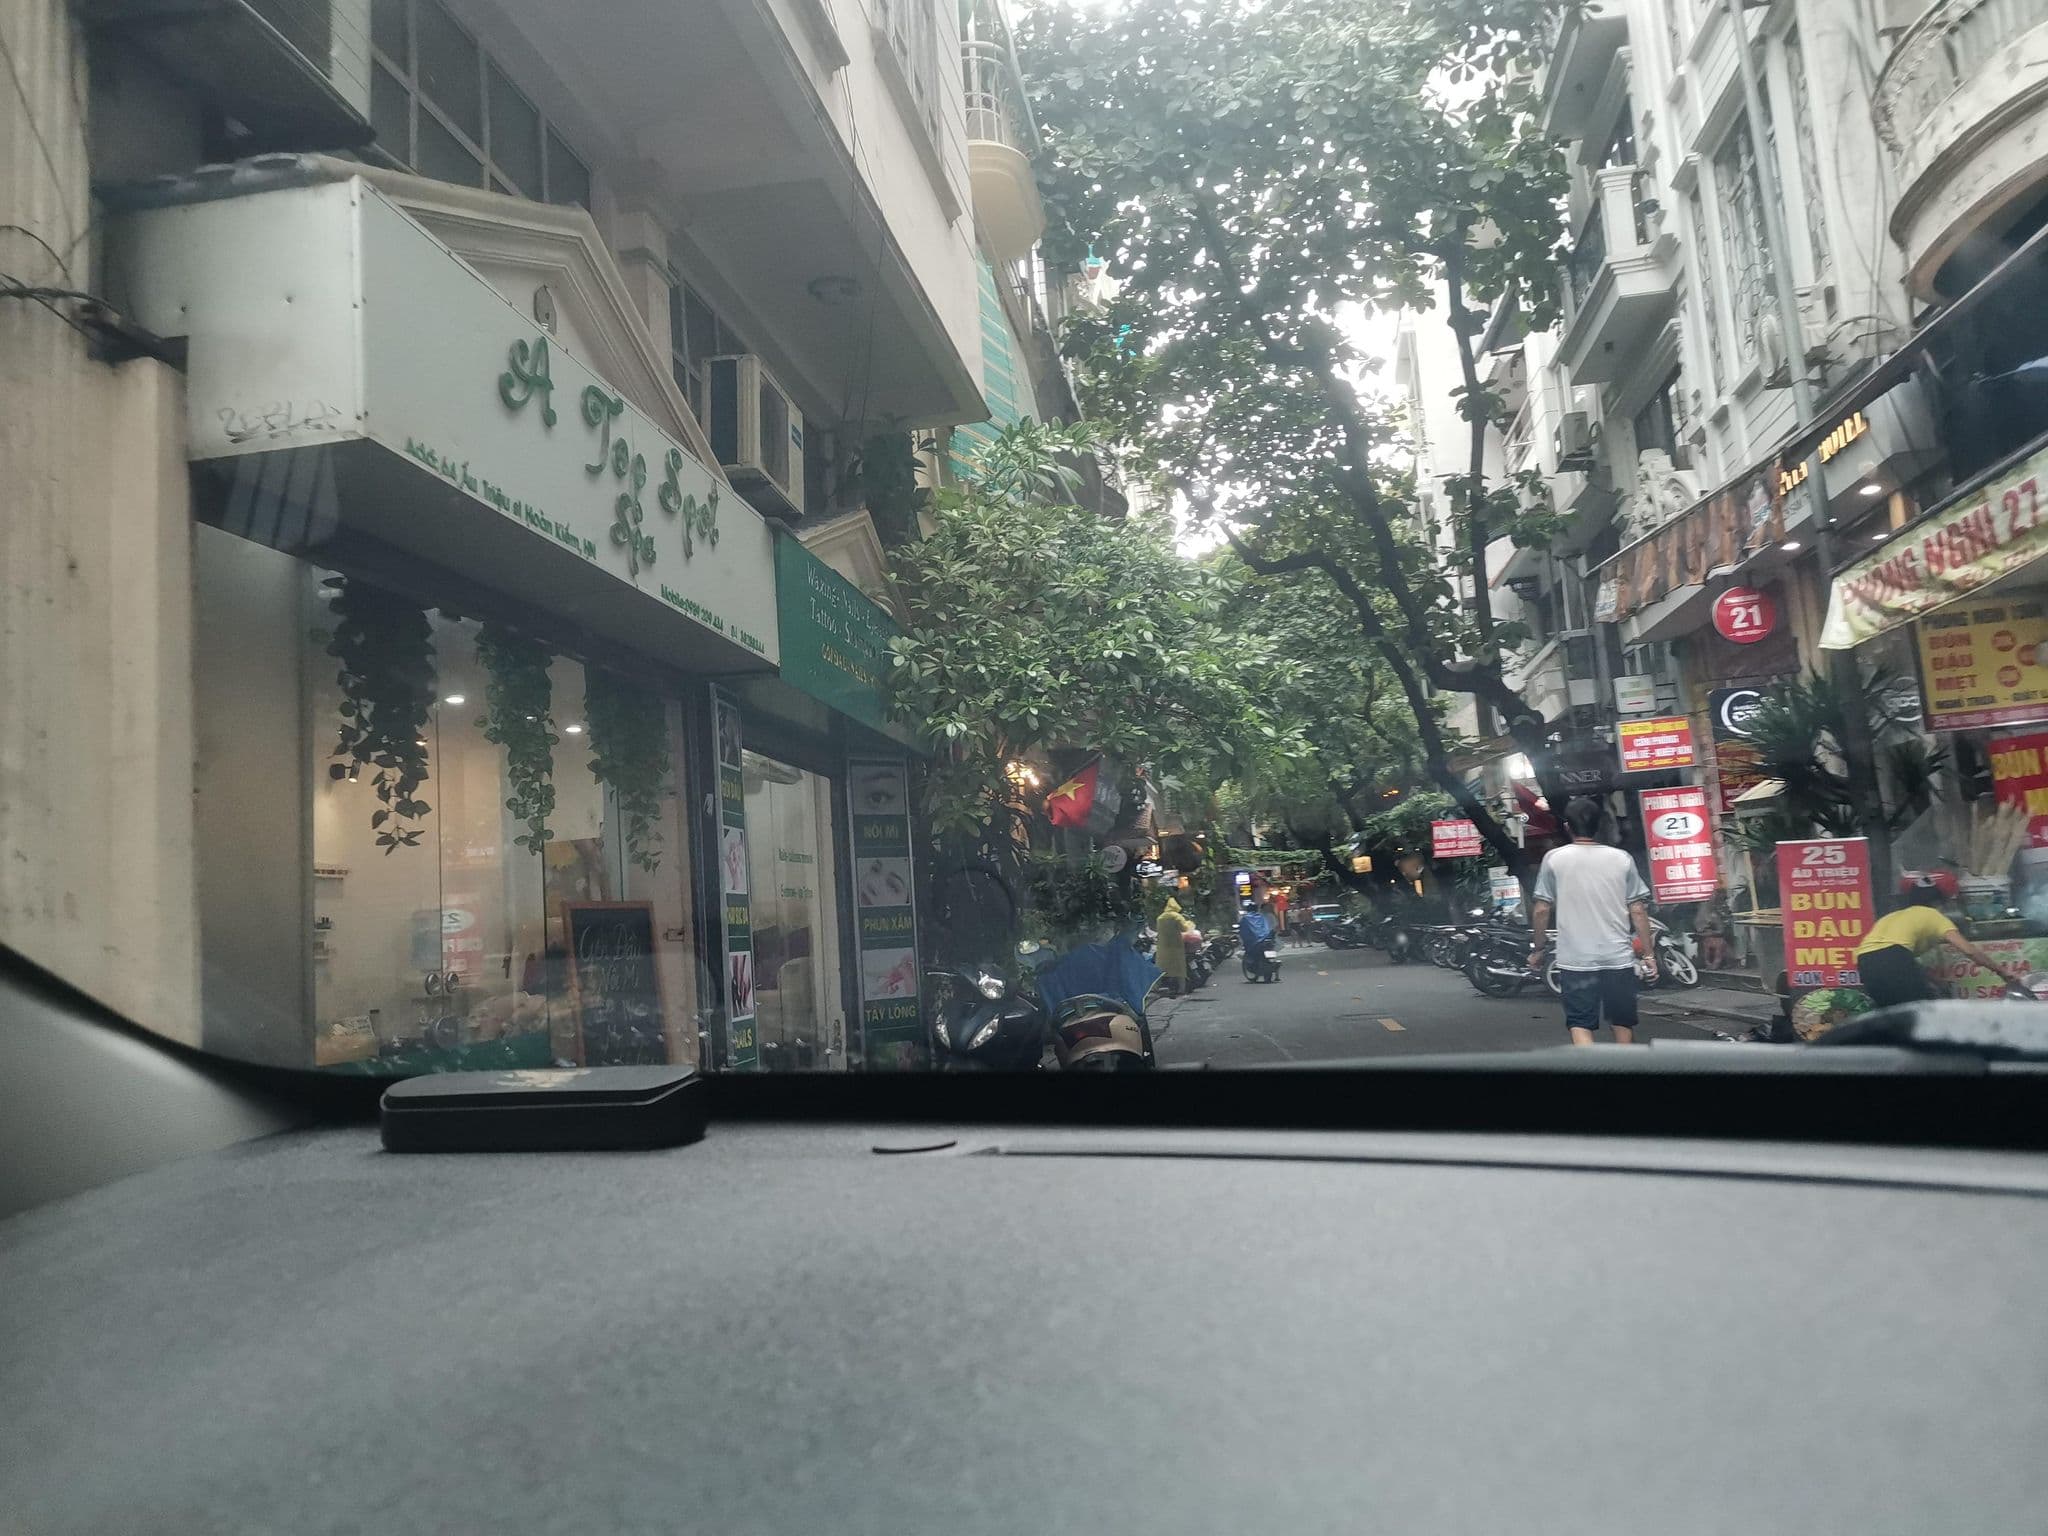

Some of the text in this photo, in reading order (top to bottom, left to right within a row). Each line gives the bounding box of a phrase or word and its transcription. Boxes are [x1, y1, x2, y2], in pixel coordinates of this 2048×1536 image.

[499, 336, 557, 428] A
[2003, 477, 2039, 540] 27
[1730, 605, 1763, 629] 21
[1666, 815, 1690, 830] 21
[1801, 845, 1846, 865] 25
[1790, 888, 1861, 912] BÚN
[1794, 916, 1862, 942] ĐẬU
[1839, 970, 1861, 986] 50
